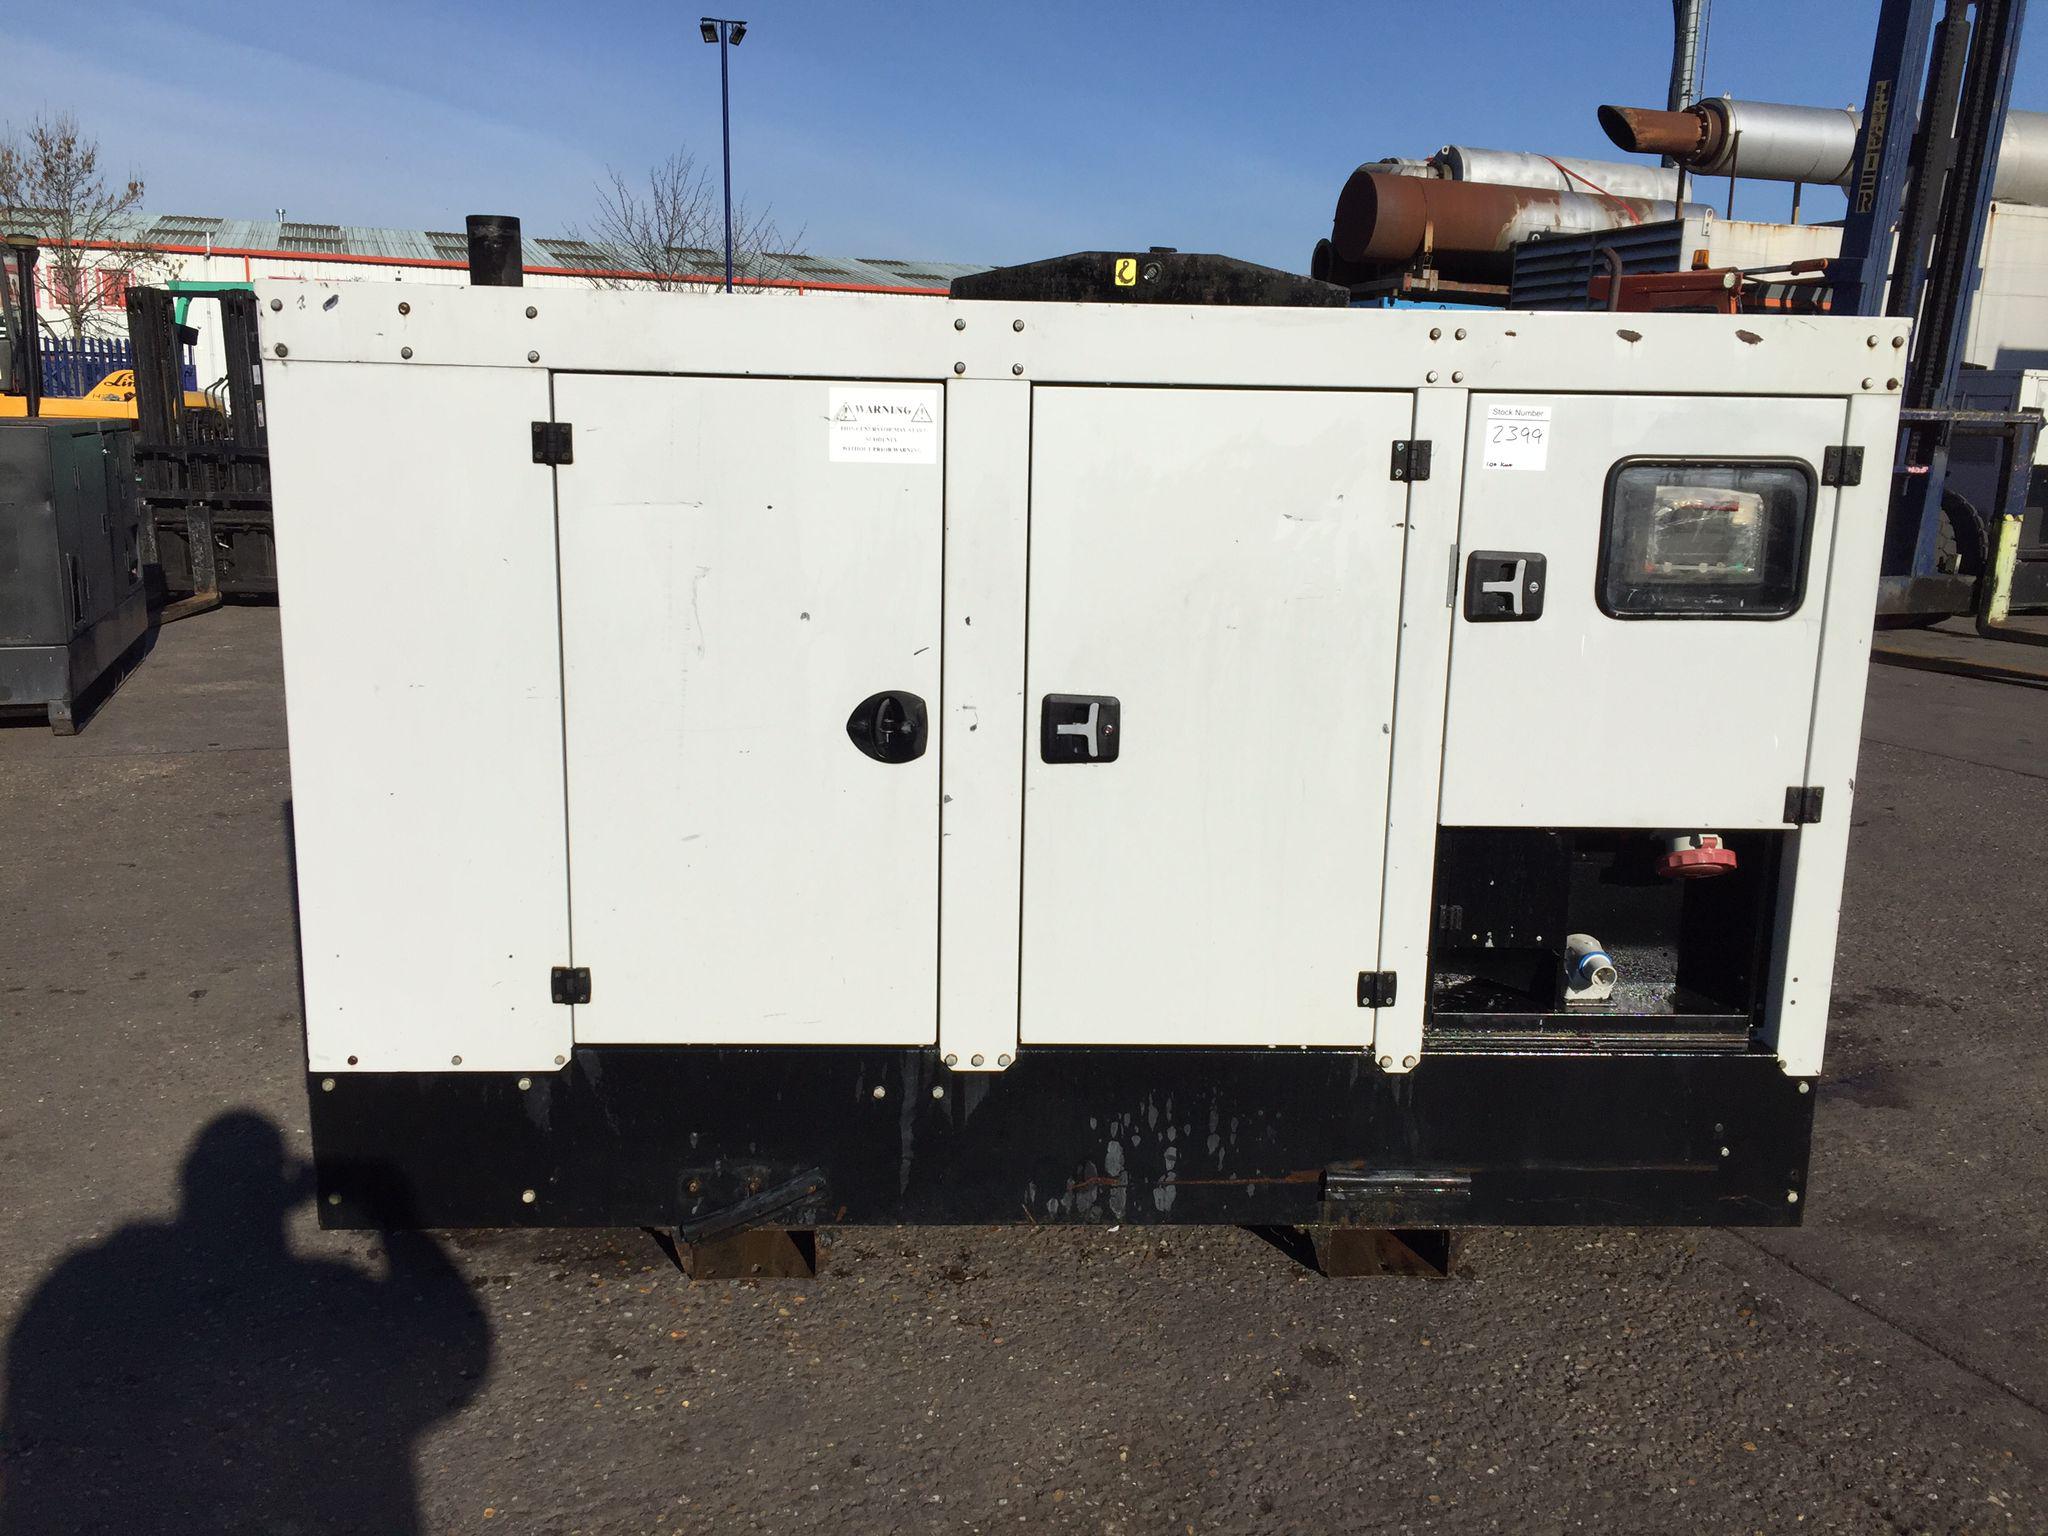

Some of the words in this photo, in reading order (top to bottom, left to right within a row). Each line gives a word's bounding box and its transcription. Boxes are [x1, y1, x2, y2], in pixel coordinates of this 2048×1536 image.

[104, 372, 136, 387] Lin
[855, 404, 912, 415] WARNING
[1492, 408, 1512, 416] Stock
[1514, 409, 1544, 417] Number
[1492, 425, 1543, 445] 2399
